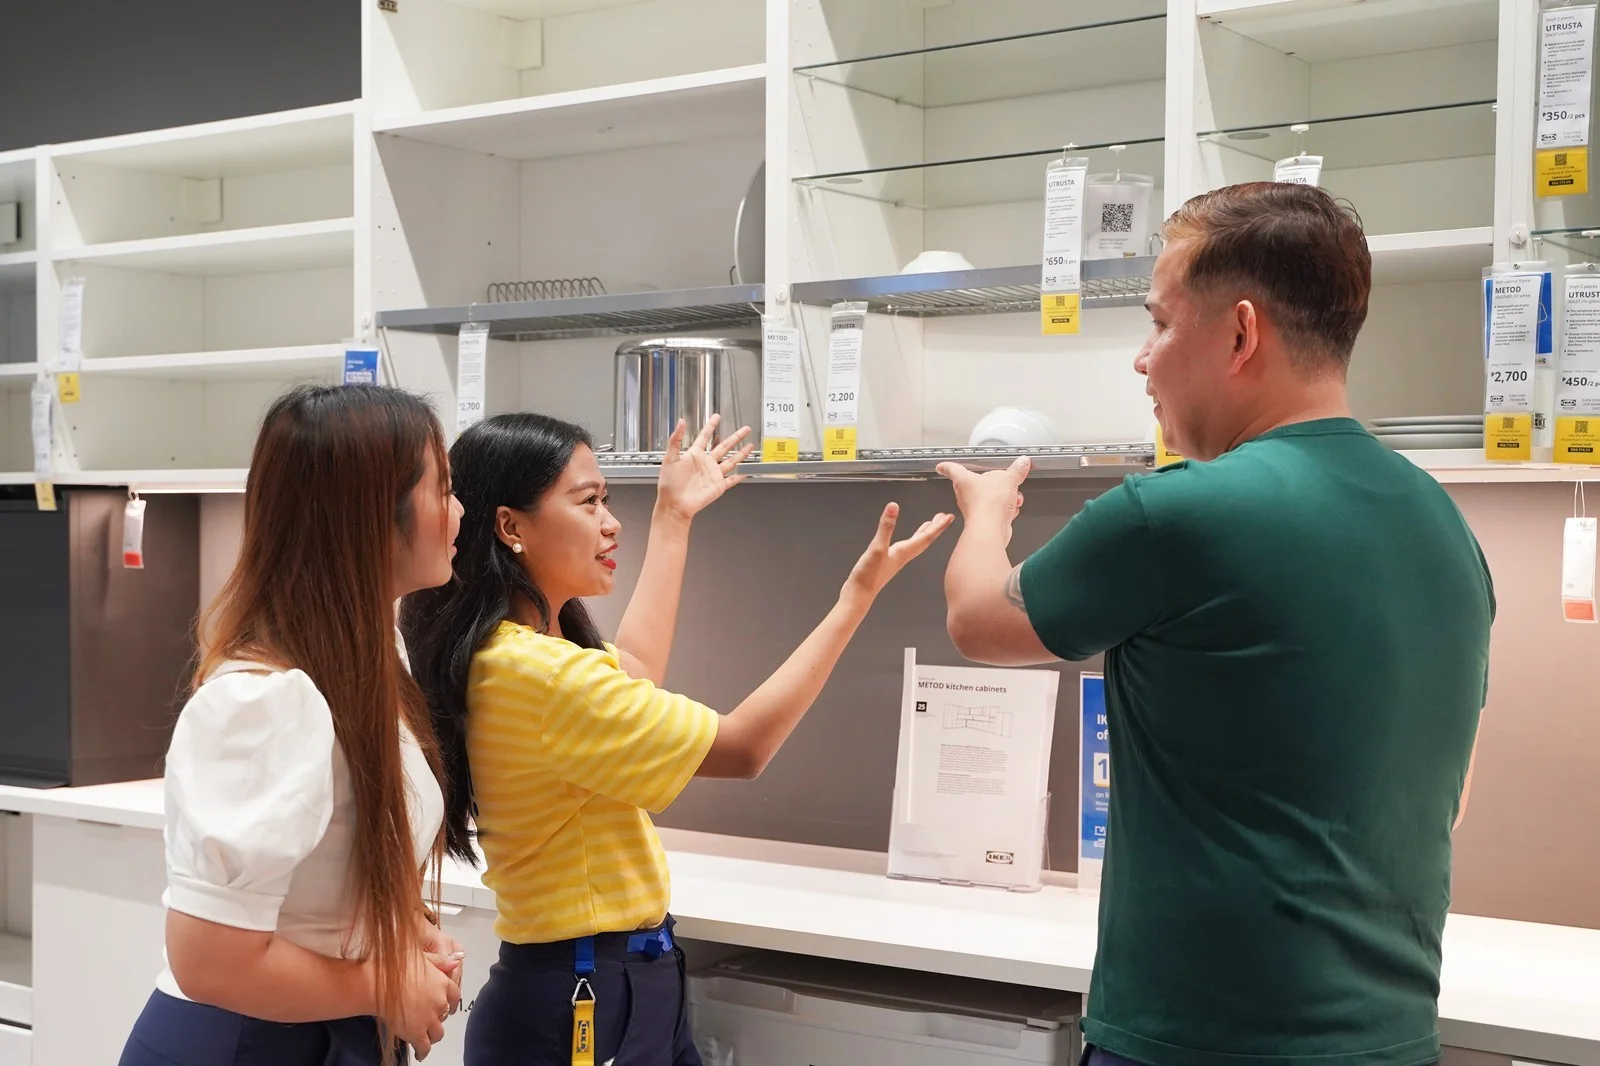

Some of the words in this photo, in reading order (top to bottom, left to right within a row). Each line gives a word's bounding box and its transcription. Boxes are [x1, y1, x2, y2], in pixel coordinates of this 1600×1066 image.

[1546, 22, 1582, 32] UTRUSTA
[1048, 180, 1074, 188] UTRUSTA
[946, 683, 973, 691] kitchen
[976, 685, 1007, 693] cabinets
